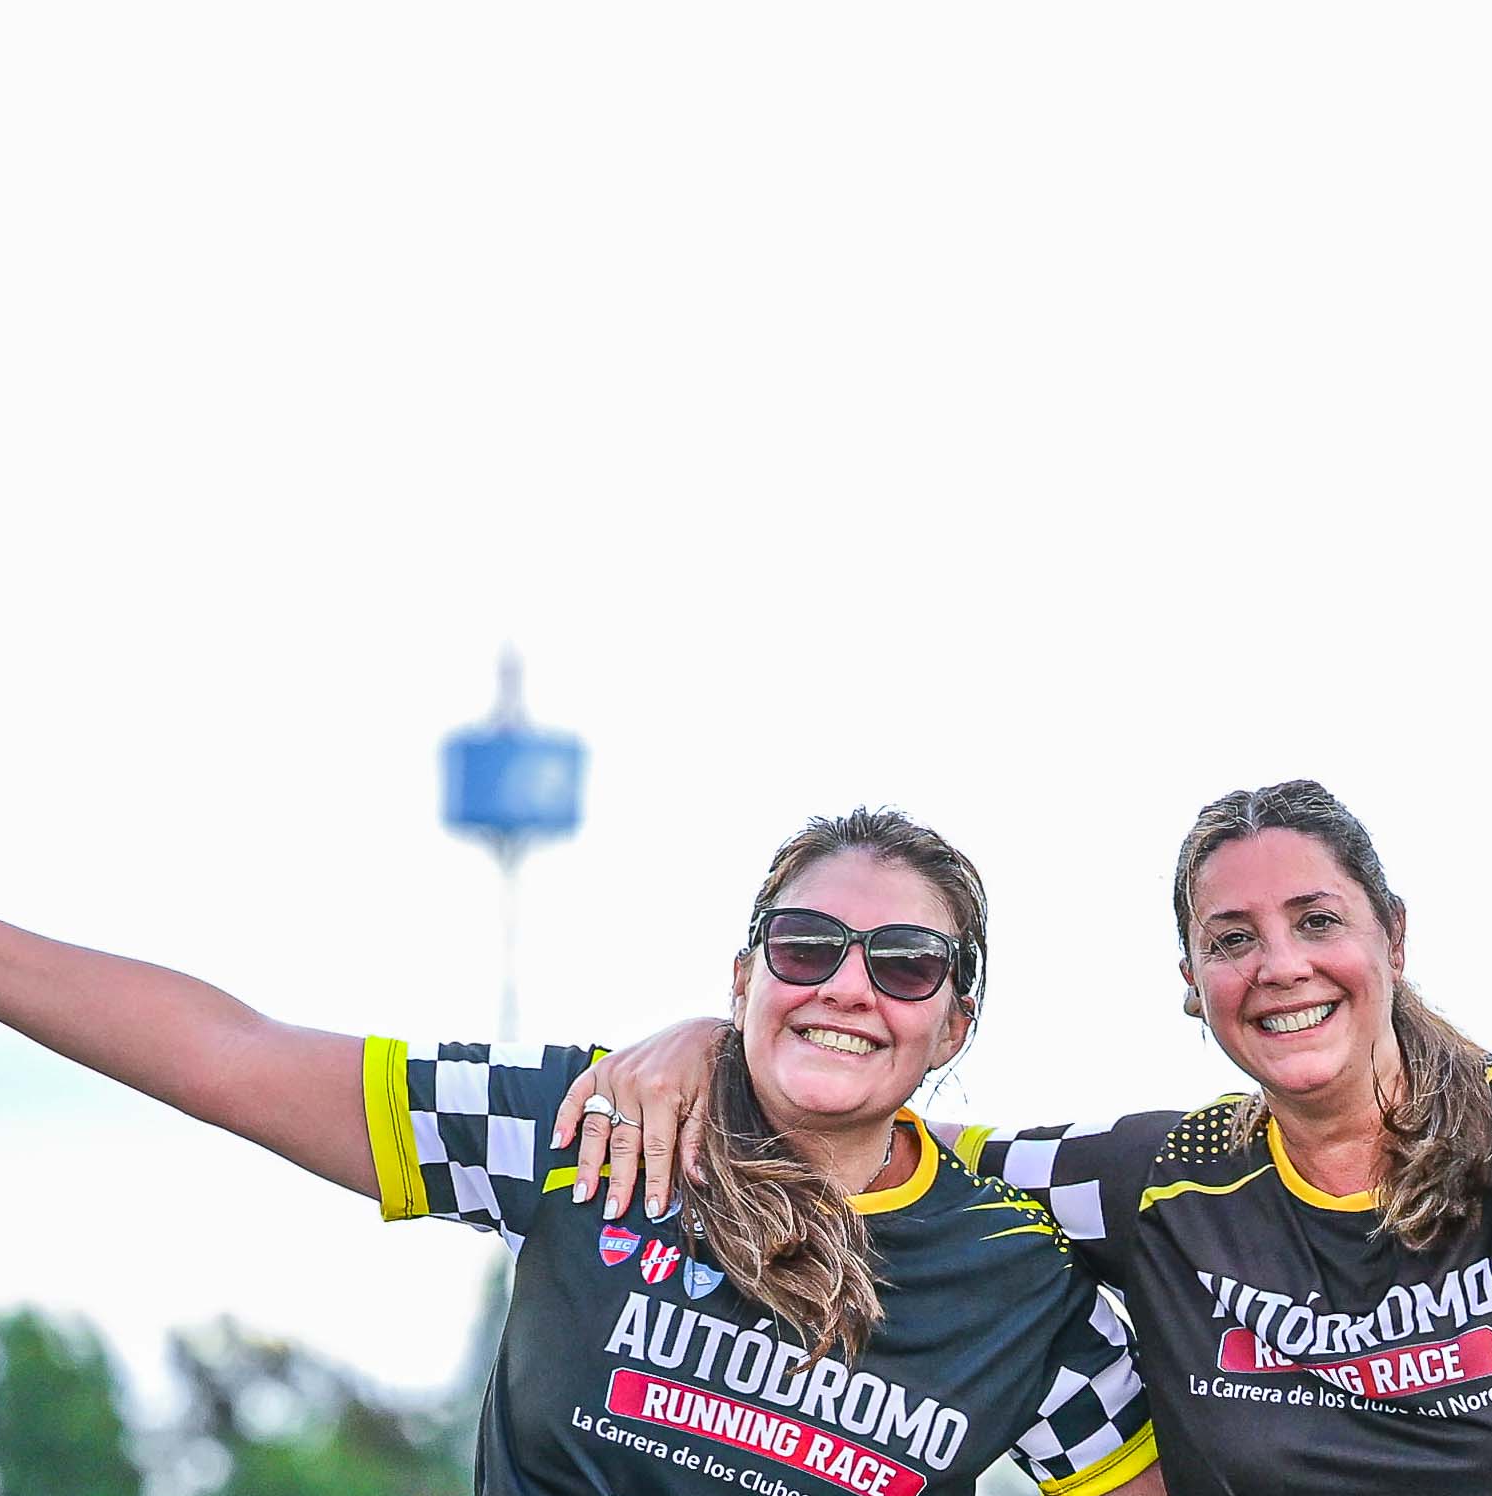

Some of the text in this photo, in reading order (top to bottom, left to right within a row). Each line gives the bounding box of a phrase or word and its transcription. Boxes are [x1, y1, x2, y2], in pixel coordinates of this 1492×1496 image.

[604, 1291, 969, 1471] AUTÓDROMO
[1188, 1374, 1207, 1396] La
[1211, 1377, 1283, 1403] Carrera
[1287, 1385, 1313, 1406] de
[1318, 1387, 1345, 1409] los
[1369, 1343, 1465, 1395] RACE
[572, 1406, 593, 1431] La
[595, 1417, 668, 1459] Carrera
[672, 1446, 701, 1470] de
[703, 1455, 736, 1482] los
[641, 1382, 802, 1458] RUNNING
